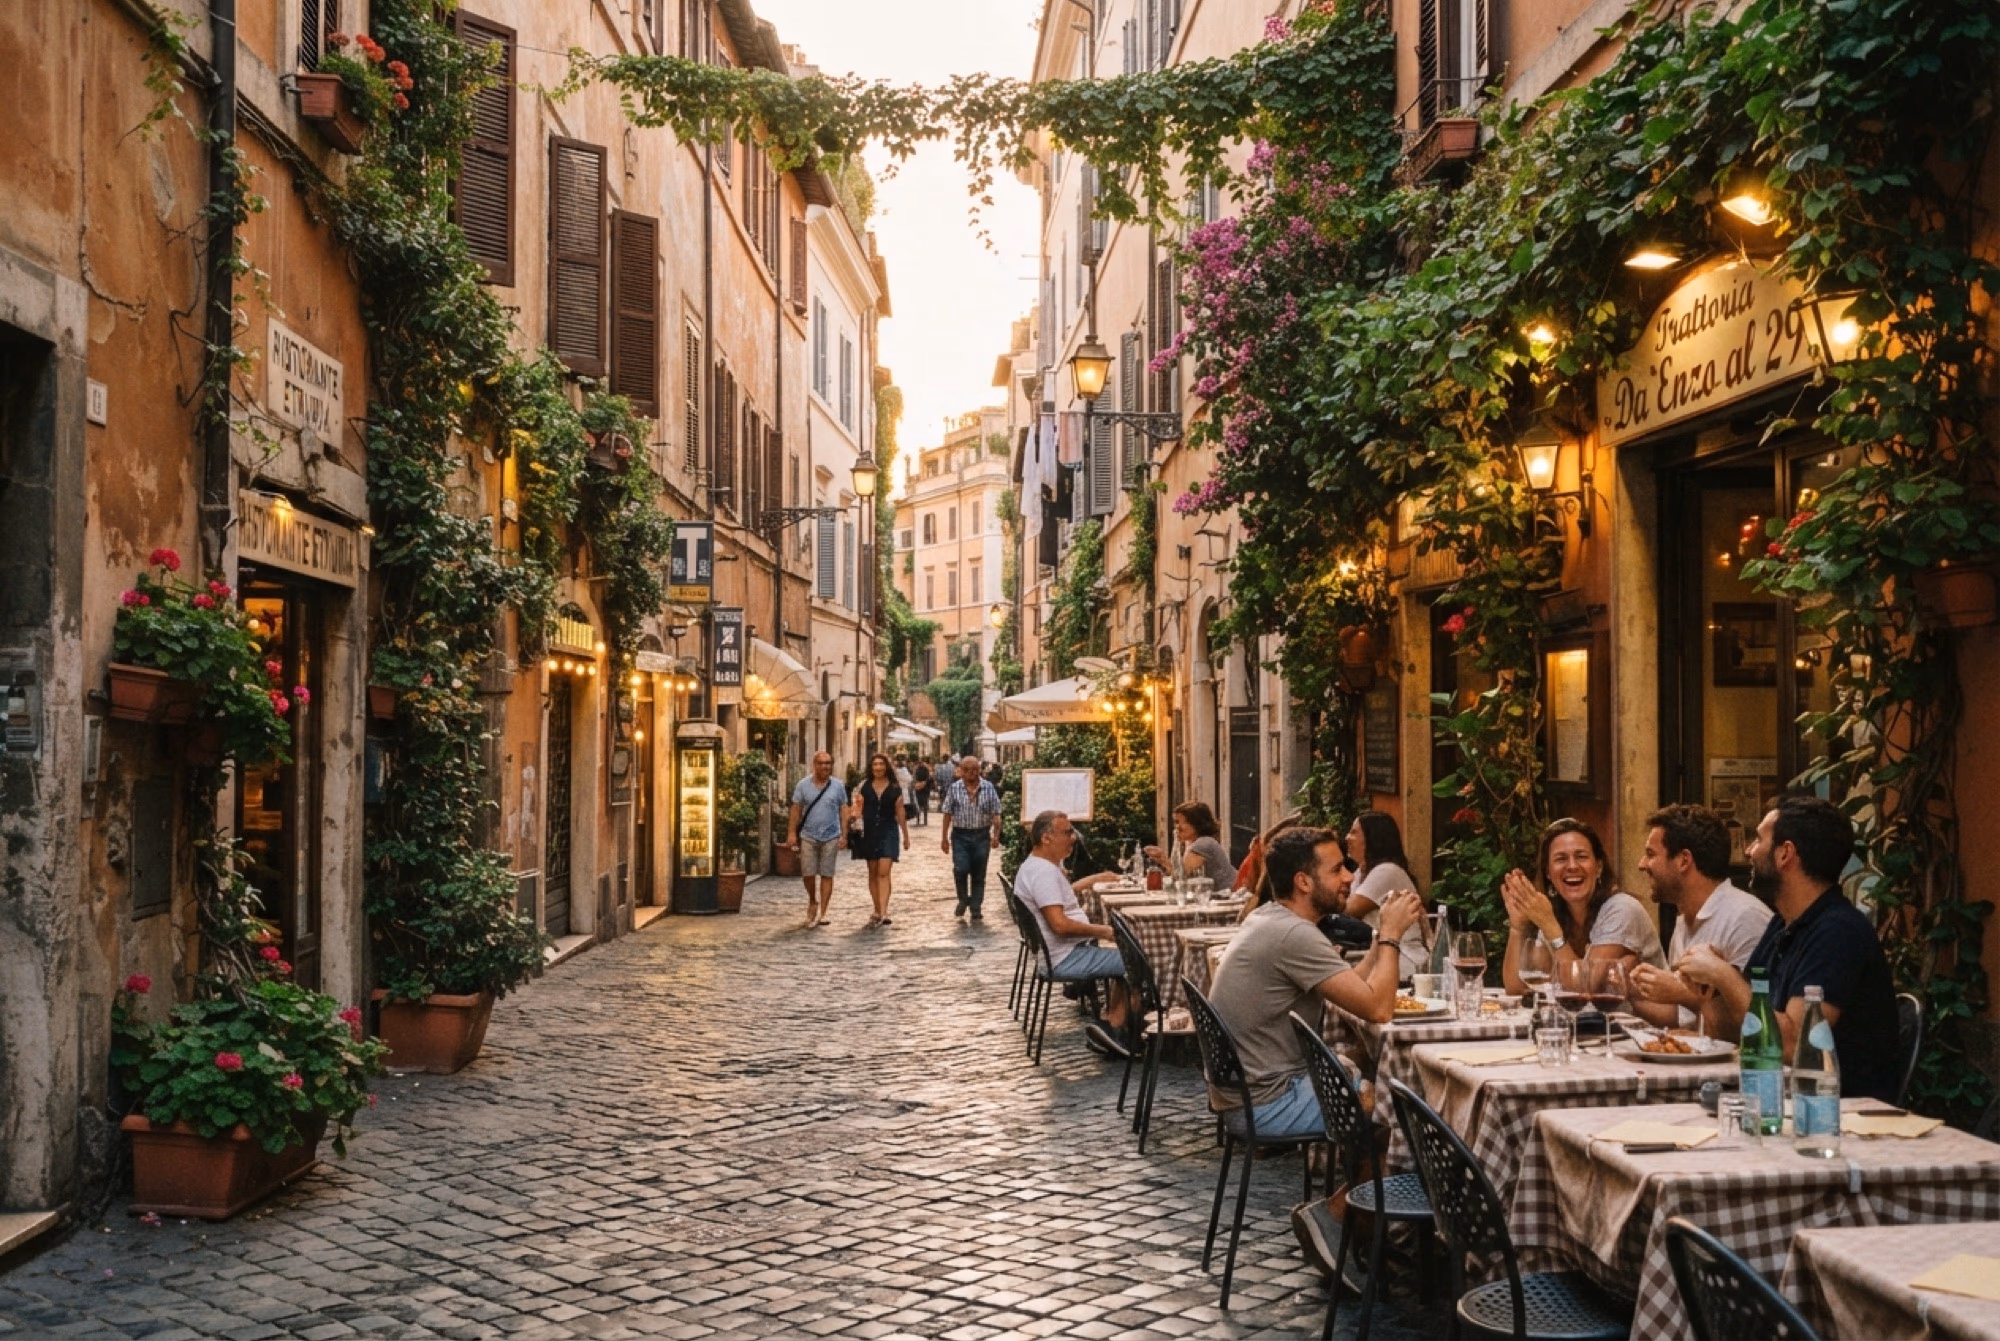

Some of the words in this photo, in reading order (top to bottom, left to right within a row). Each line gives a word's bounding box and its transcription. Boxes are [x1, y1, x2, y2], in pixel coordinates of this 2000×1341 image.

[1655, 279, 1755, 352] Trattoria
[1614, 377, 1650, 430] Da
[1726, 318, 1757, 389] al
[1765, 297, 1804, 374] 29
[676, 527, 708, 580] T
